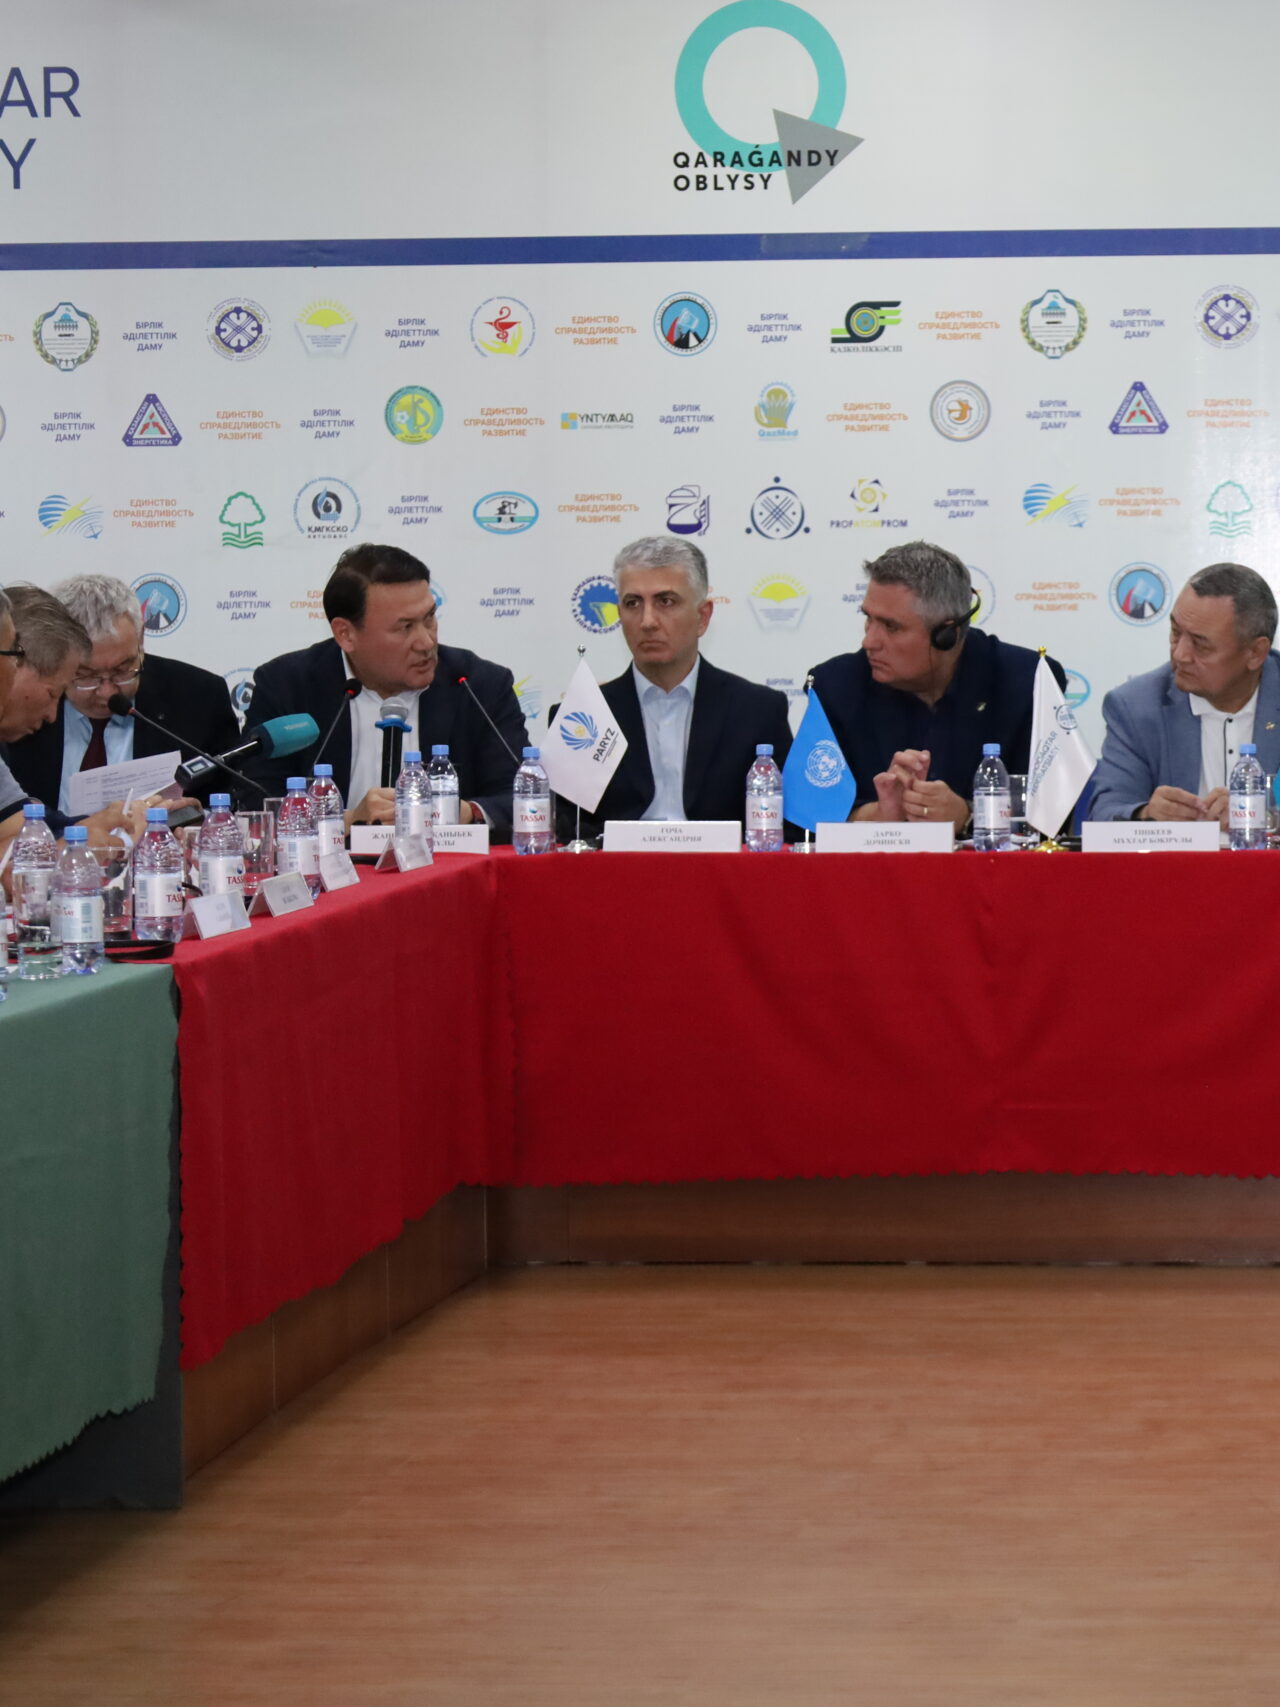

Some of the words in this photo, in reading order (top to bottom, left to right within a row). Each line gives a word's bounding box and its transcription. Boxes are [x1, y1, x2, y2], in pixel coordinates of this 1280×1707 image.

[673, 174, 772, 191] OBLYSY
[760, 313, 788, 321] БІРЛІК
[935, 311, 983, 319] ЕДИНСТВО
[398, 318, 426, 326] БІРЛІК
[571, 316, 619, 324] ЕДИНСТВО
[918, 322, 1000, 330] СПРАВЕДЛИВОСТЬ
[554, 326, 636, 335] СПРАВЕДЛИВОСТЬ
[761, 335, 787, 343] ДАМУ
[1124, 331, 1150, 339] ДАМУ
[399, 340, 425, 348] ДАМУ
[573, 337, 618, 345] РАЗВИТИЕ
[137, 343, 162, 351] ДАМУ
[672, 404, 700, 412] БІРЛІК
[843, 403, 891, 411] ЕДИНСТВО
[216, 411, 263, 419] ЕДИНСТВО
[480, 408, 528, 416] ЕДИНСТВО
[826, 413, 908, 421] СПРАВЕДЛИВОСТЬ
[200, 421, 281, 430] СПРАВЕДЛИВОСТЬ
[464, 418, 545, 426] СПРАВЕДЛИВОСТЬ
[1040, 422, 1067, 430] ДАМУ
[673, 426, 699, 434] ДАМУ
[845, 424, 890, 432] РАЗВИТИЕ
[218, 432, 263, 440] РАЗВИТИЕ
[314, 431, 340, 439] ДАМУ
[758, 429, 799, 438] QazMed
[55, 434, 81, 442] ДАМУ
[574, 493, 622, 502] ЕДИНСТВО
[130, 499, 176, 507] ЕДИНСТВО
[557, 504, 640, 512] СПРАВЕДЛИВОСТЬ
[402, 517, 428, 525] ДАМУ
[576, 515, 621, 523] РАЗВИТИЕ
[131, 520, 176, 528] РАЗВИТИЕ
[229, 590, 257, 598] БІРЛІК
[493, 587, 521, 595] БІРЛІК
[231, 612, 256, 620] ДАМУ
[494, 609, 520, 617] ДАМУ
[593, 727, 615, 762] PARYZ
[520, 814, 546, 822] TASSAY
[752, 811, 778, 819] TASSAY
